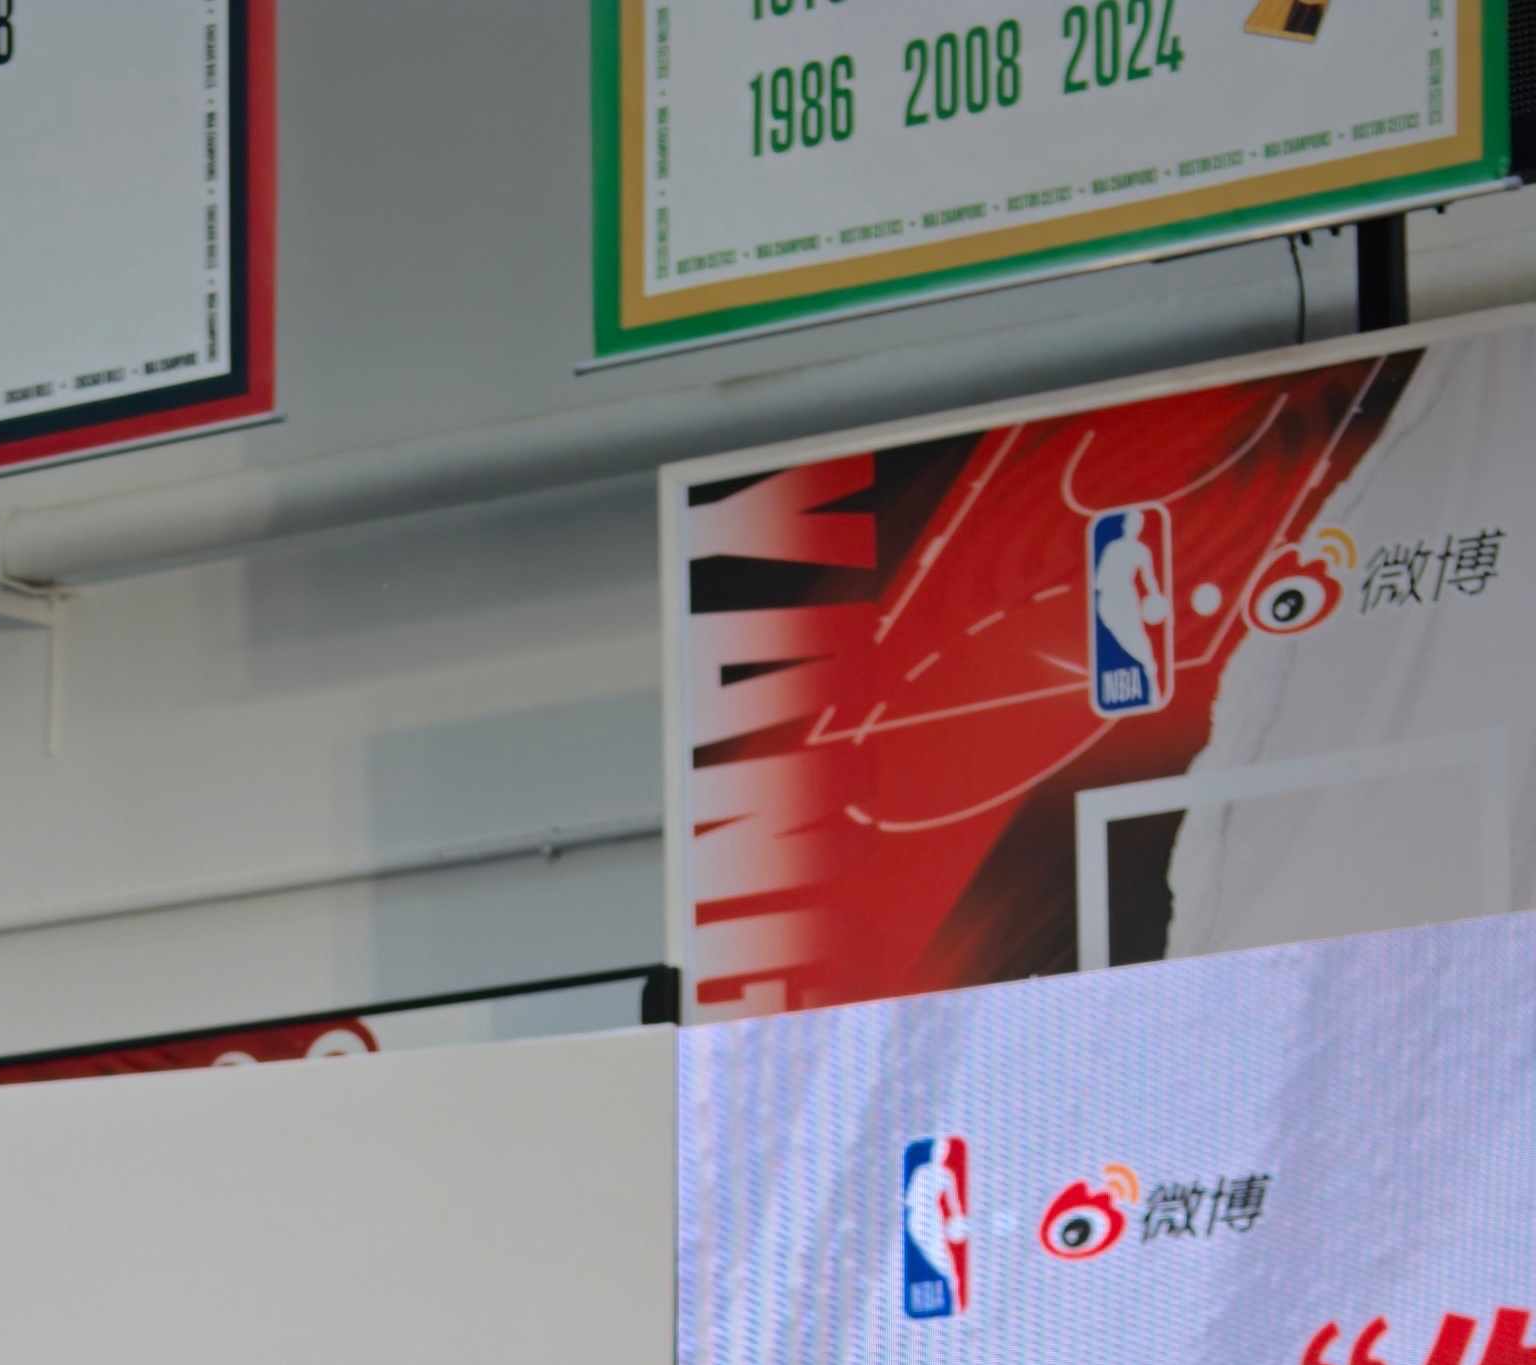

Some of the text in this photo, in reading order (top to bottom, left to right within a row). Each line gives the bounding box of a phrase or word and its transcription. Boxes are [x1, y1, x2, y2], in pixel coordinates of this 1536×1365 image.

[750, 0, 1184, 157] 1986 2008 2024
[1360, 530, 1507, 616] 微博
[1101, 667, 1144, 705] NBA
[1141, 1173, 1272, 1243] 微博
